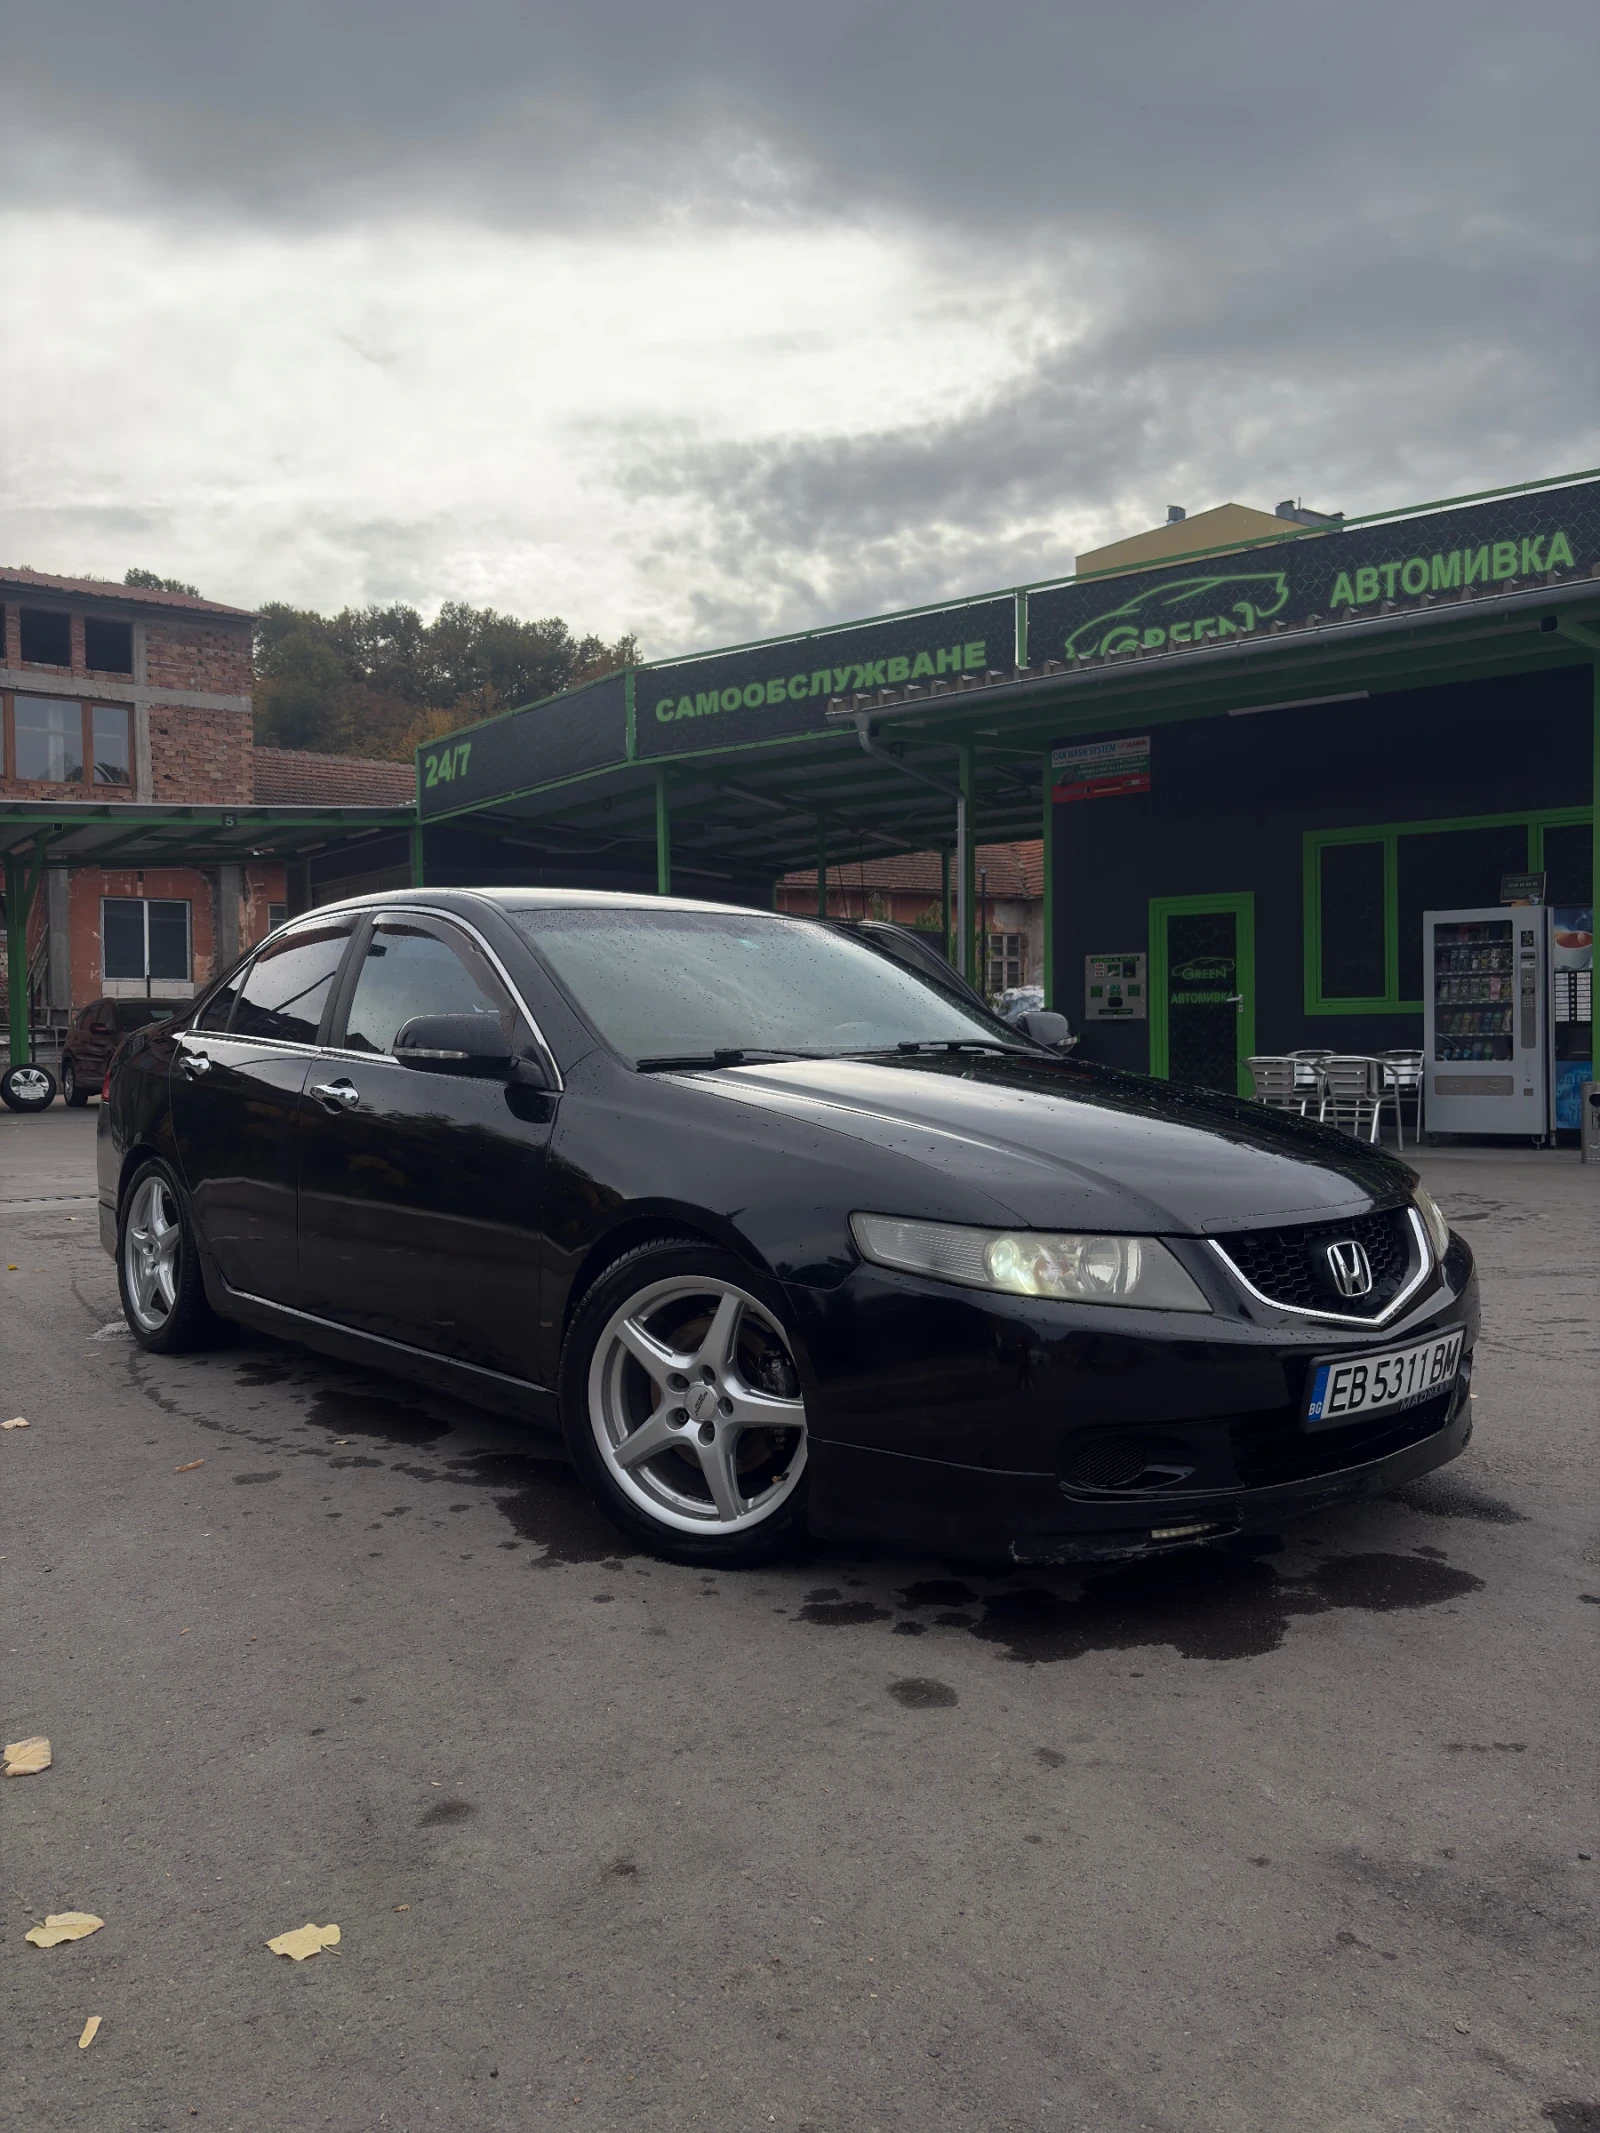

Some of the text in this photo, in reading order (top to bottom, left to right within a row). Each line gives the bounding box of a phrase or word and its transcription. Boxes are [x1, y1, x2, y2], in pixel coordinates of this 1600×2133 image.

[1331, 531, 1575, 608] АВТОМИВКА
[655, 640, 987, 723] САМООБСЛУЖВАНЕ
[1053, 750, 1067, 761] CAR
[1067, 747, 1088, 758] WASH
[1089, 743, 1116, 755] SYSTEM
[425, 743, 472, 788] 24/7
[225, 816, 234, 827] 5
[1182, 965, 1226, 980] GREEN
[1308, 1401, 1322, 1416] BG
